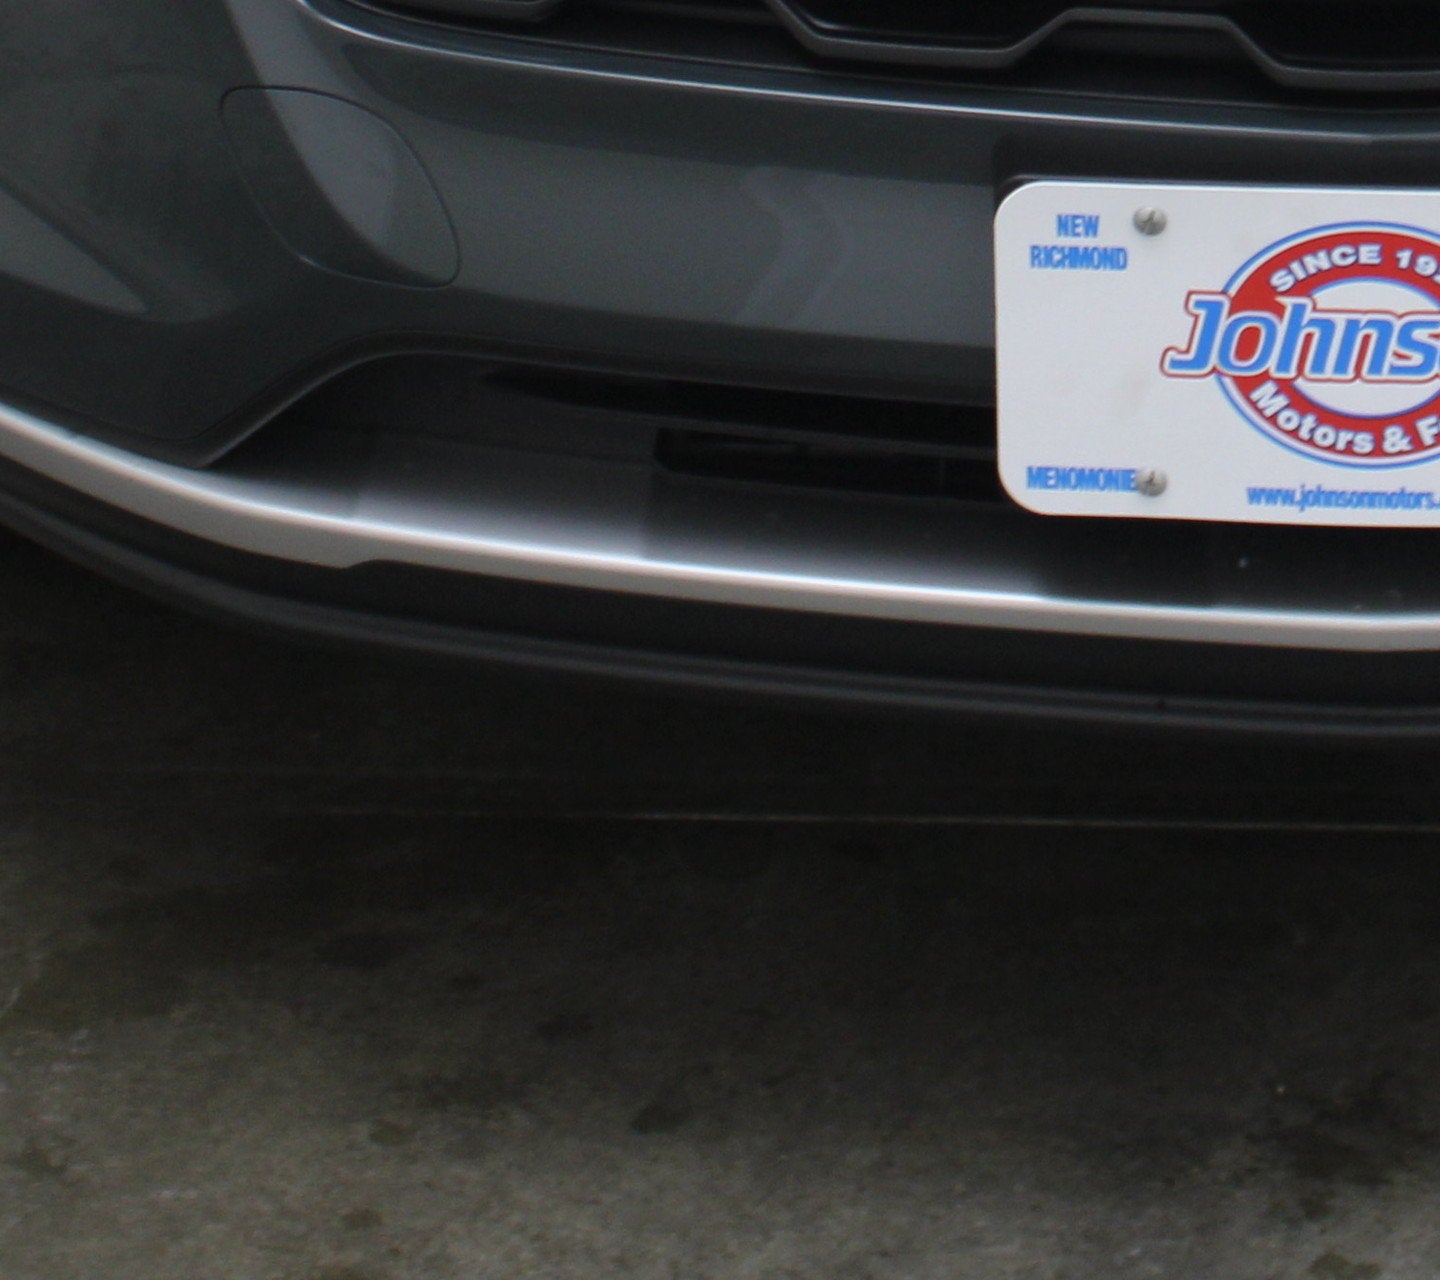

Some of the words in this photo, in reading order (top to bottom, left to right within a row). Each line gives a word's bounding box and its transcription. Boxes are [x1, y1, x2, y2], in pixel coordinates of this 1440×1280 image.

[1056, 215, 1100, 238] NEW
[1030, 245, 1128, 271] RICHMOND
[1270, 243, 1383, 293] SINCE
[1250, 380, 1375, 455] Motors
[1382, 426, 1412, 454] &
[1027, 466, 1138, 492] MENOMONIE
